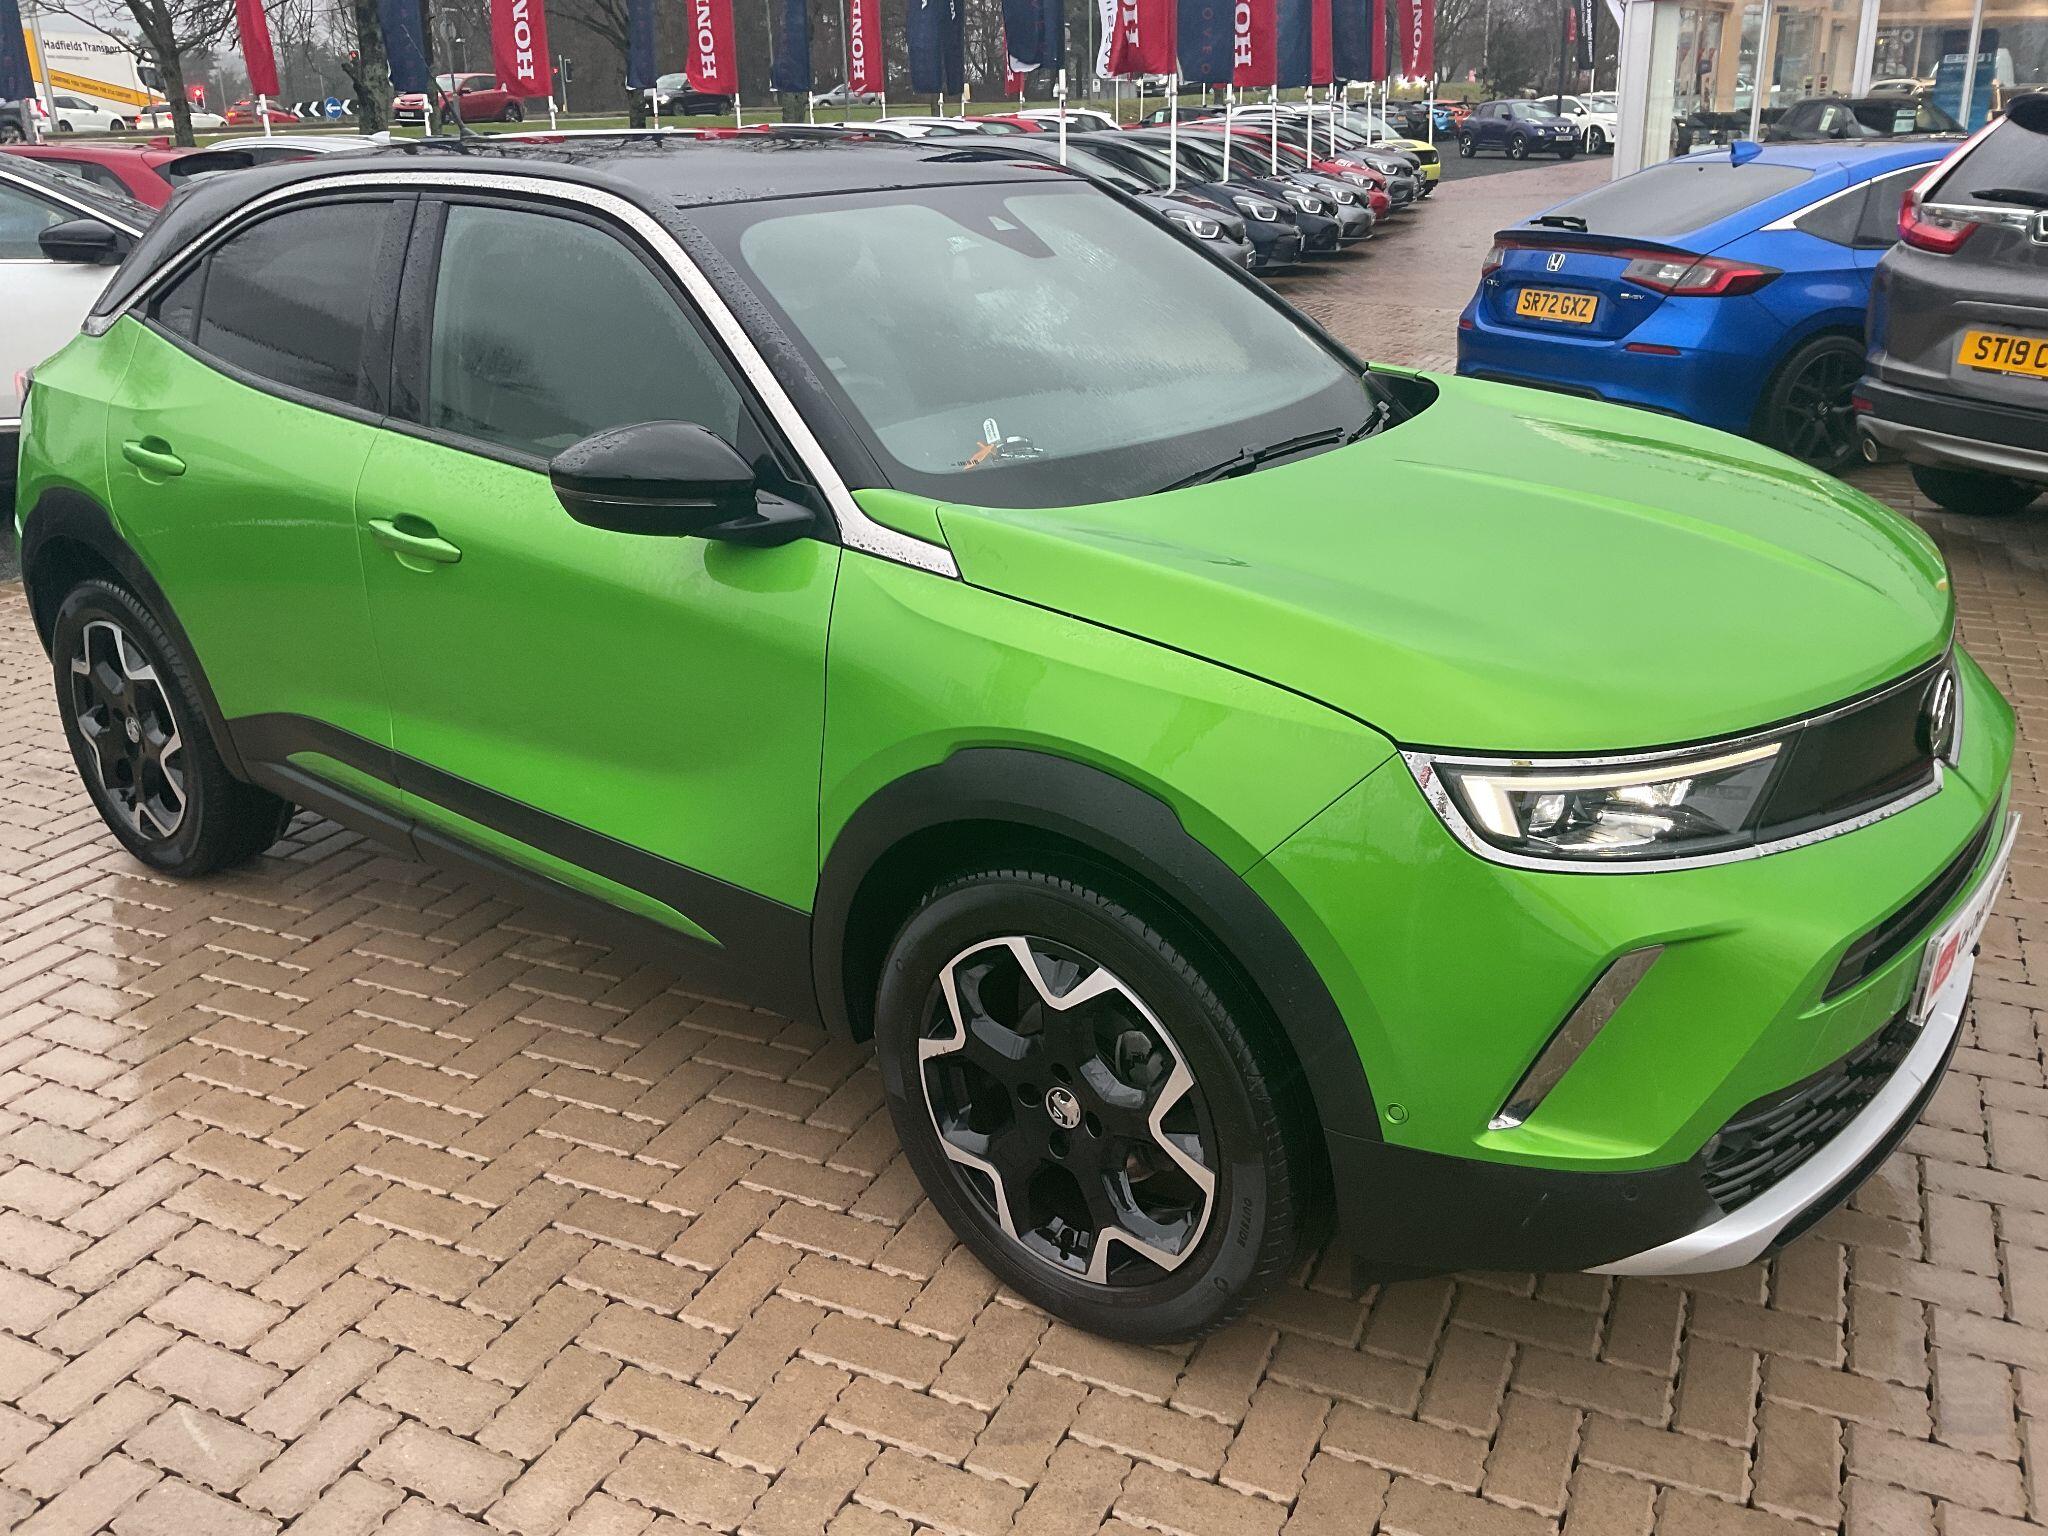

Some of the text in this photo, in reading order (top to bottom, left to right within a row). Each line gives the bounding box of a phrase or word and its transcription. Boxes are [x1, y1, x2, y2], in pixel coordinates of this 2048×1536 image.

[43, 40, 121, 54] Hadfields Transport
[1522, 291, 1591, 318] SR72 GXZ
[1974, 335, 2031, 365] ST19
